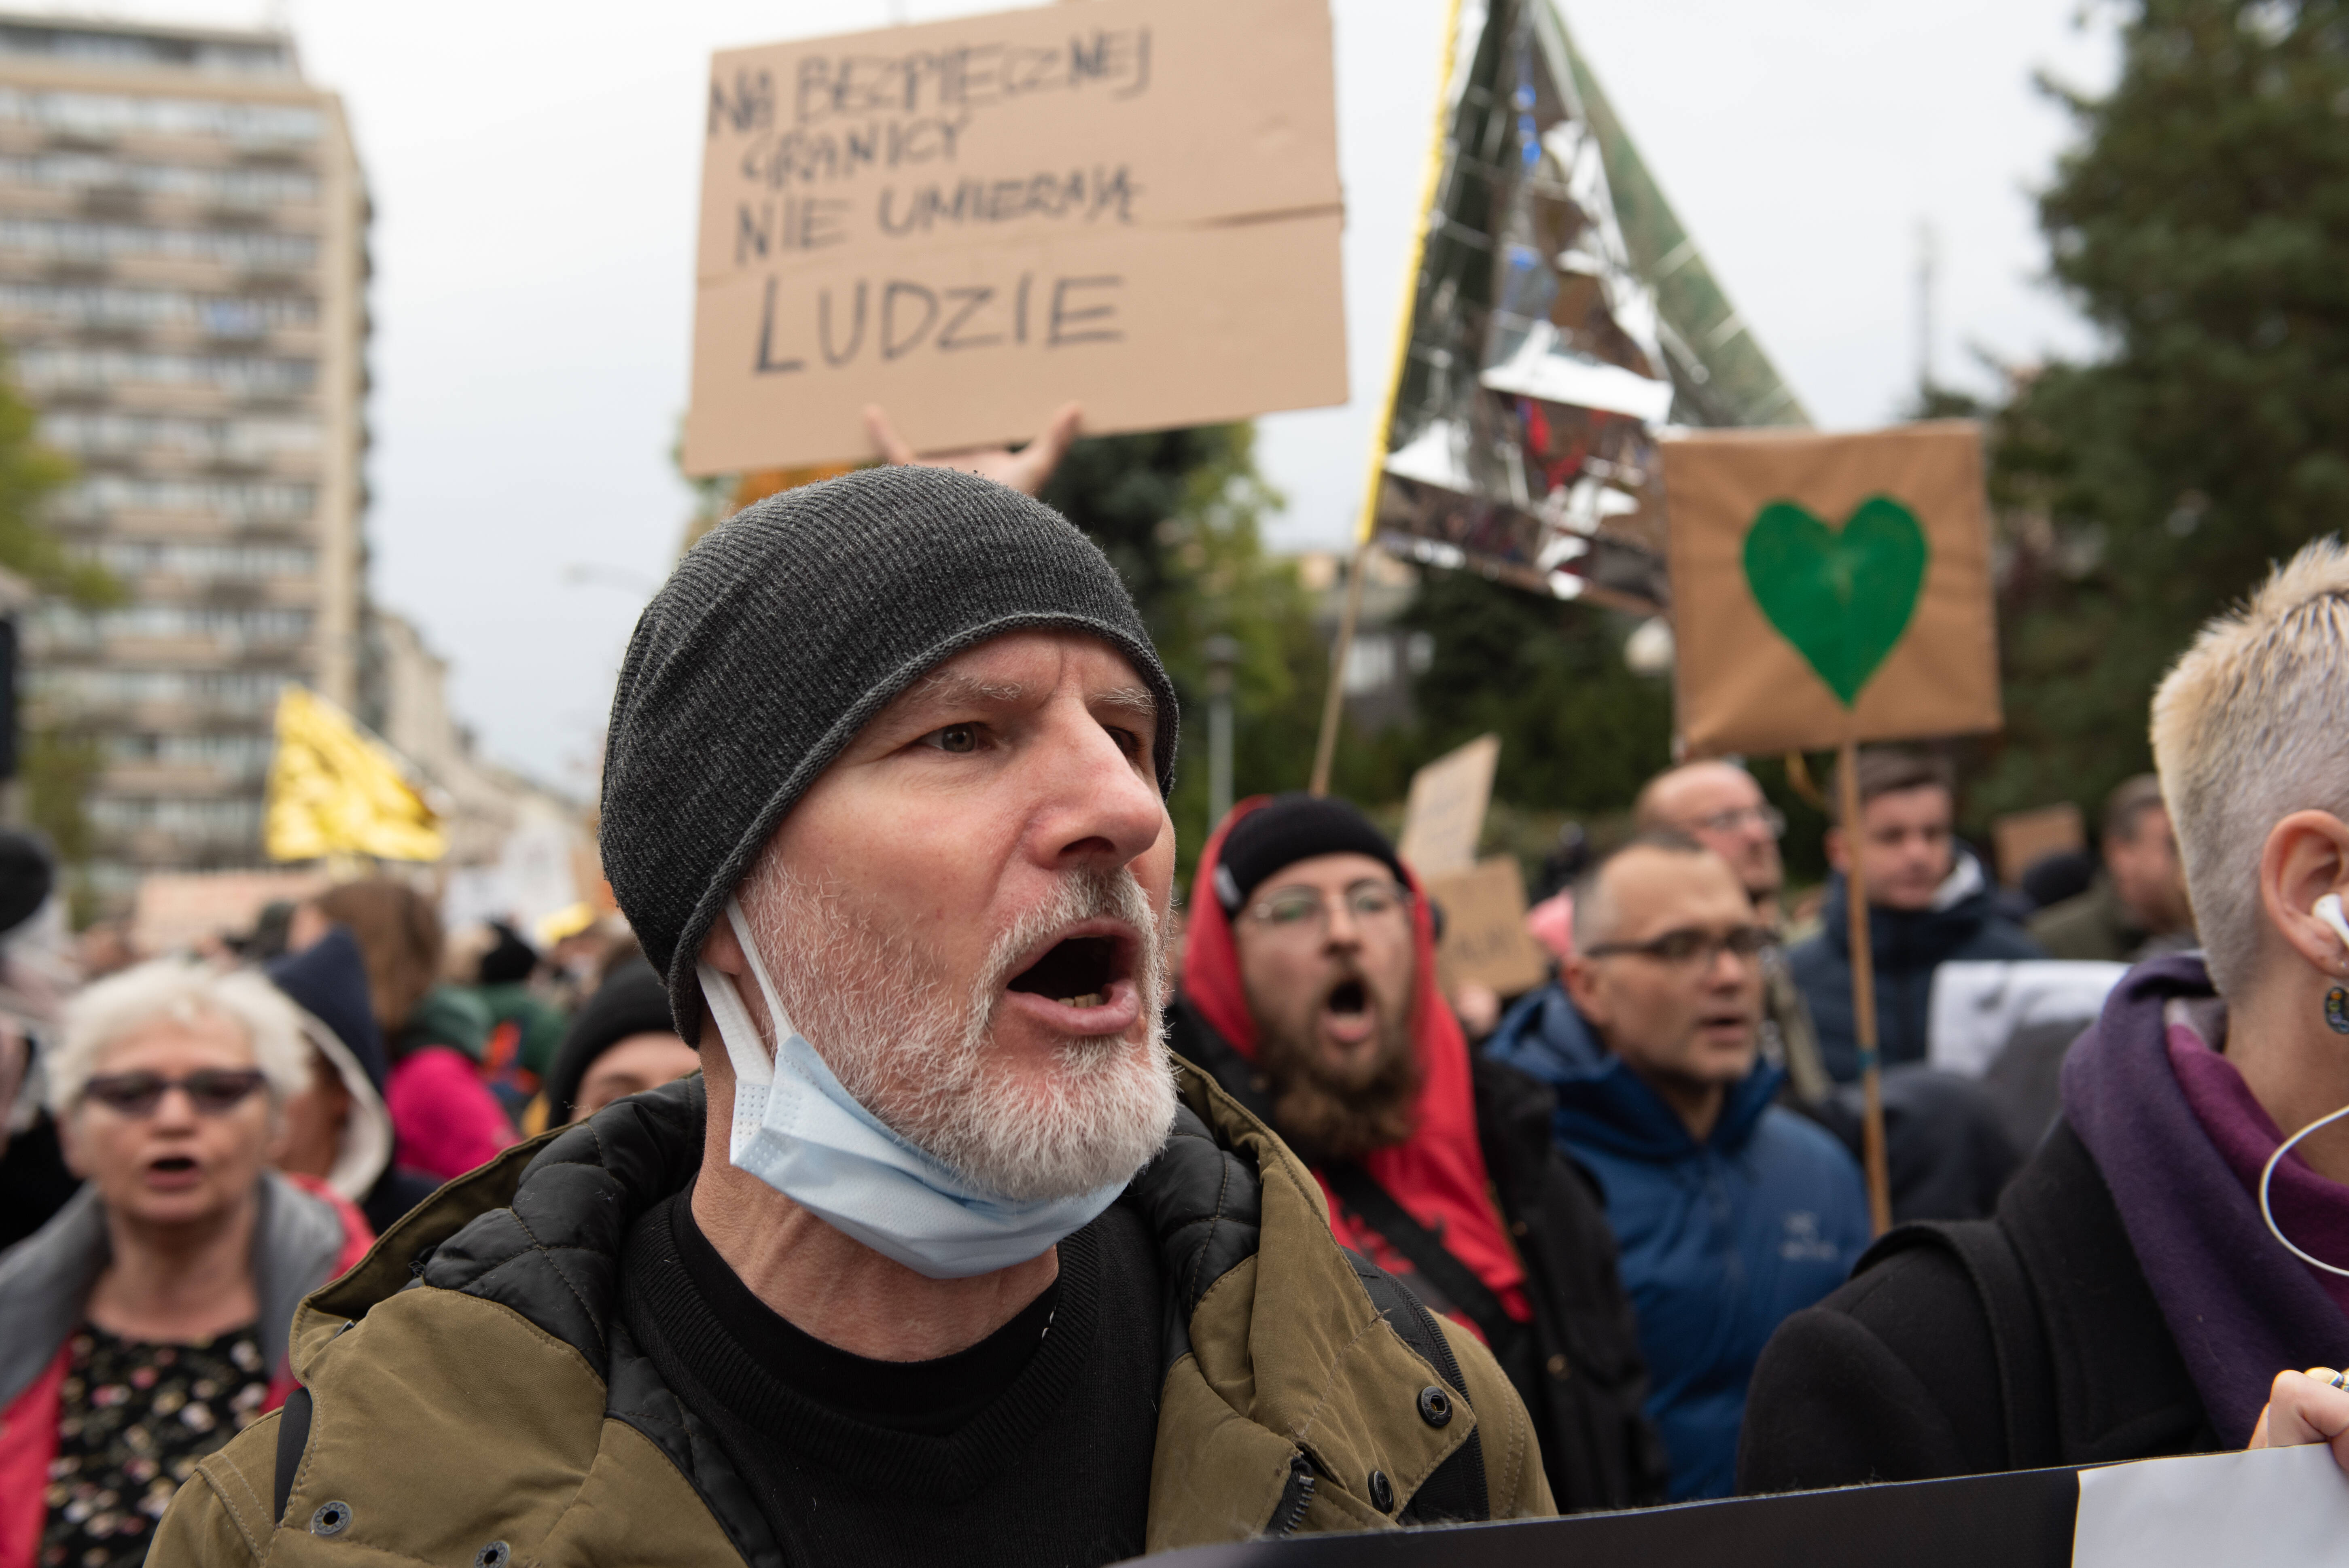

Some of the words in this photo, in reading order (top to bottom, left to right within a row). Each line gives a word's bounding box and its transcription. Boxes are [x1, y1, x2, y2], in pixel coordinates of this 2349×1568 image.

[796, 27, 1151, 122] BEZPIECZNEJ
[742, 115, 972, 188] GRANICY
[735, 199, 850, 264] NIE
[754, 272, 1125, 374] LUDZIE
